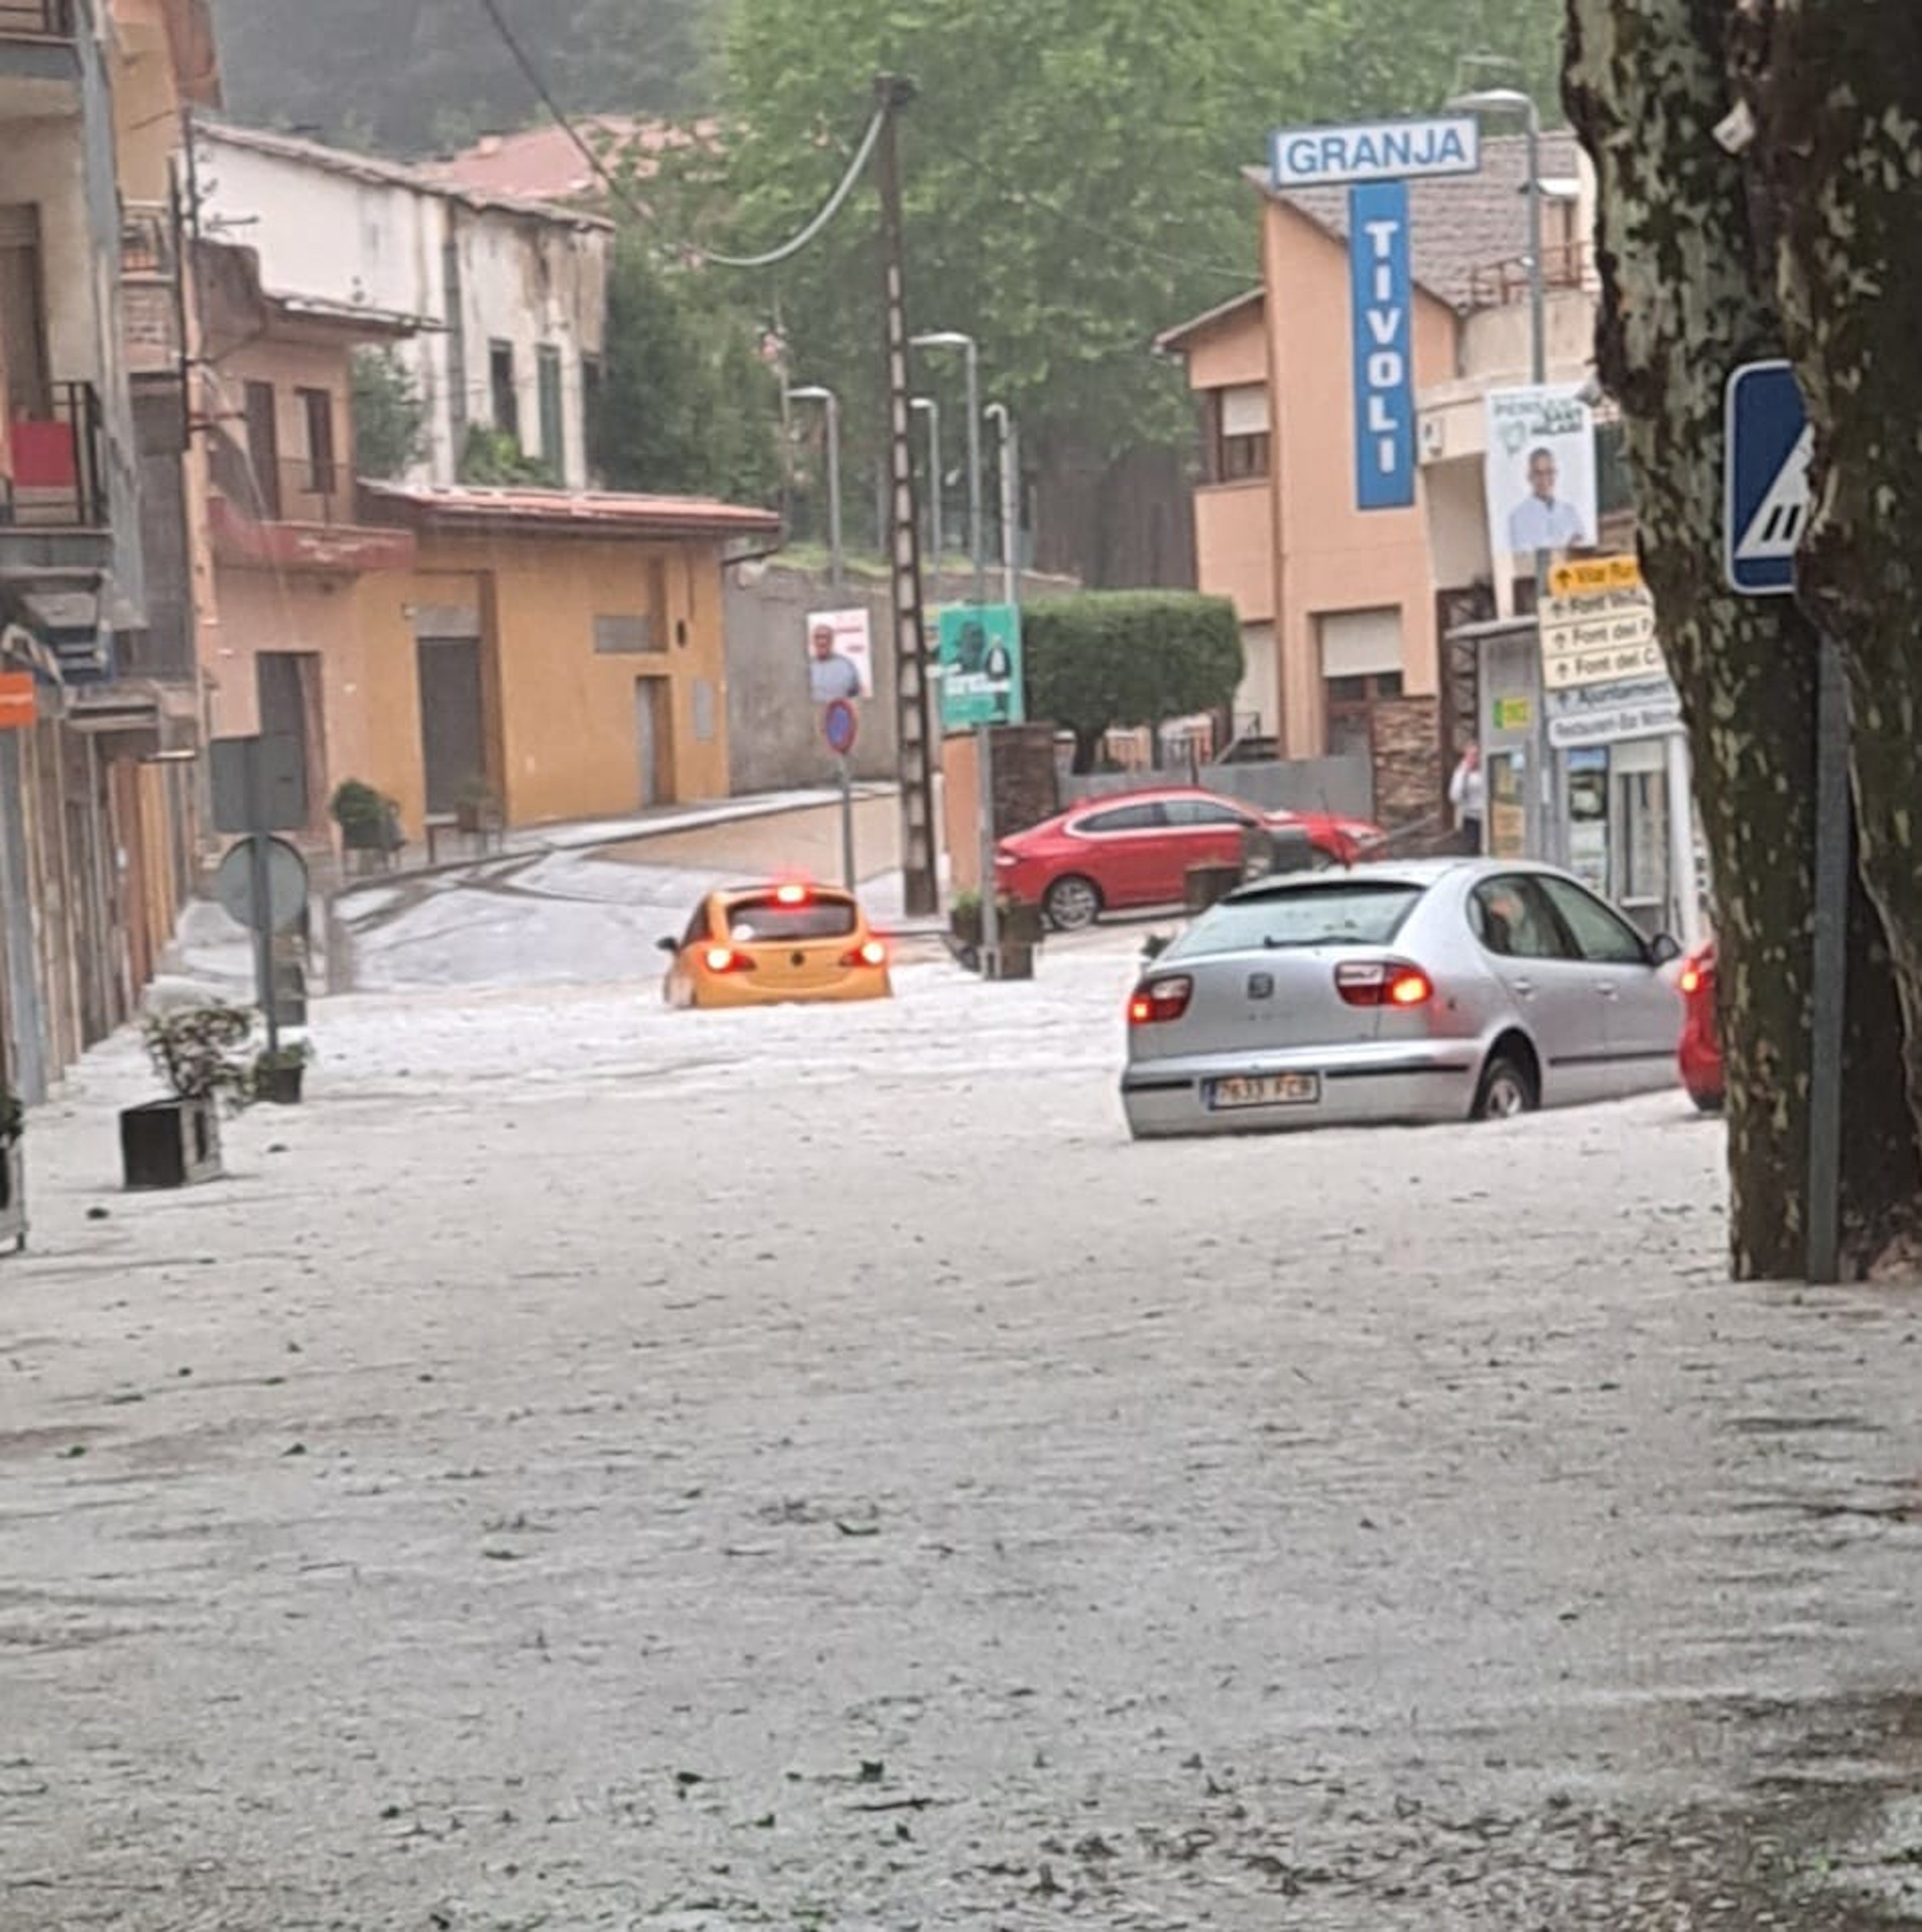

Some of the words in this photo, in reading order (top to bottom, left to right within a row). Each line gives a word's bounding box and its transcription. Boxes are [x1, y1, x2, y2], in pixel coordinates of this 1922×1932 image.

[1287, 128, 1466, 175] GRANJA
[1364, 220, 1403, 474] TIVOLI
[1572, 626, 1608, 646] Font
[1575, 656, 1611, 675] Font
